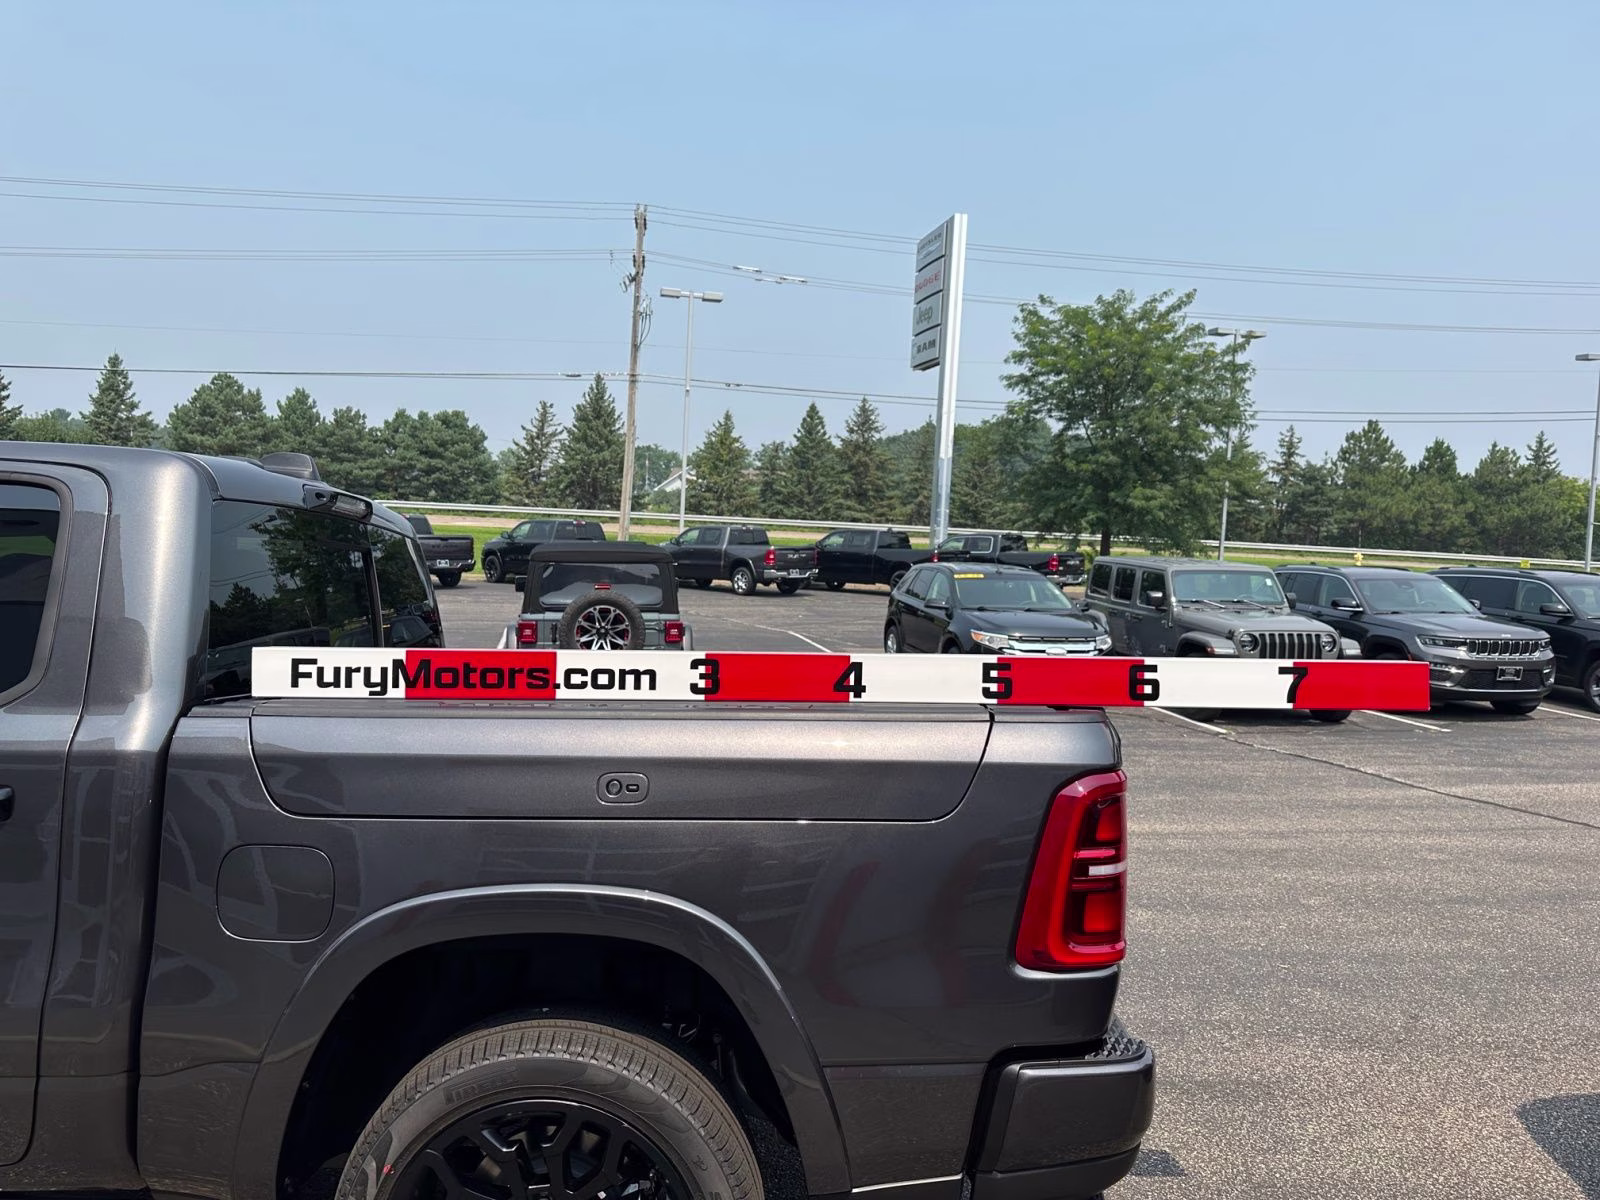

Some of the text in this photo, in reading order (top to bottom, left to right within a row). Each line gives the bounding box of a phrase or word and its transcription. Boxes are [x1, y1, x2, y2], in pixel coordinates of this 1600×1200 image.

[916, 306, 933, 325] Jeep
[916, 339, 936, 354] RAM
[290, 657, 1308, 704] FuryMotors.com 3 4 5 6 7
